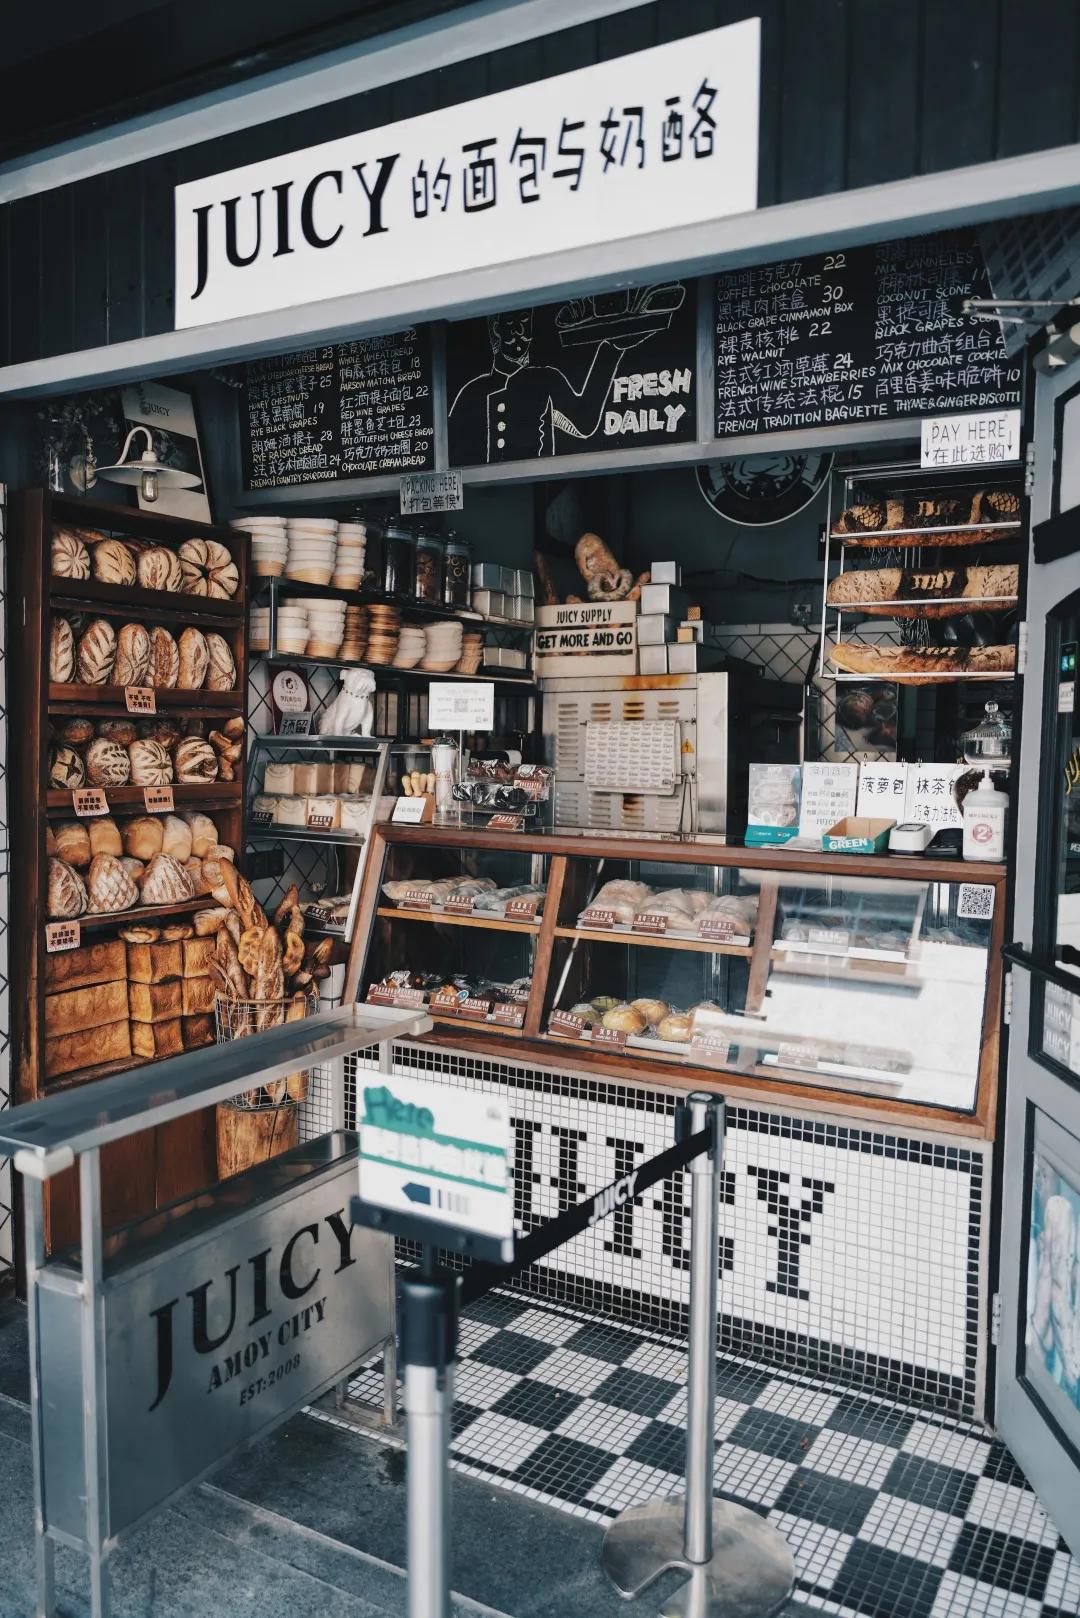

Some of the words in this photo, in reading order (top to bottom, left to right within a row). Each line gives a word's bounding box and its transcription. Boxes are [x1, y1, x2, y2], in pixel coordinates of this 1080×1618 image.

[191, 154, 401, 300] JUICY
[411, 78, 718, 219] 的面包与奶酪
[824, 253, 847, 270] 22
[717, 286, 757, 302] COFFEE
[760, 274, 822, 294] CHOCOLATE
[877, 288, 932, 305] COCONUT
[936, 283, 972, 299] SCONE
[718, 288, 809, 321] 黑提肉桂盒
[822, 285, 844, 304] 30
[875, 298, 952, 326] 黑提司康
[716, 320, 746, 334] BLACK
[748, 315, 778, 328] GRAPE
[778, 306, 832, 323] CINNAMON
[834, 302, 854, 314] BOX
[874, 322, 911, 340] BLACK
[915, 317, 964, 332] GRAPES
[404, 331, 418, 342] 22
[720, 326, 800, 354] 裸麦核桃
[808, 322, 832, 338] 22
[875, 328, 992, 362] 巧克力曲奇组合
[338, 354, 362, 366] WHOLE
[410, 356, 420, 368] 18
[718, 354, 738, 366] RYE
[741, 347, 786, 362] WALNUT
[880, 363, 904, 374] MIX
[906, 354, 963, 371] CHOCOLATE
[366, 376, 396, 388] MATCHA
[397, 370, 422, 383] BREAD
[718, 352, 830, 386] 法式红酒草莓
[834, 352, 854, 370] 24
[320, 374, 332, 388] 25
[612, 368, 692, 402] FRESH
[718, 384, 758, 400] FRENCH
[760, 378, 788, 392] WINE
[790, 366, 876, 388] STRAWBERRIES
[875, 364, 1006, 398] 百里香姜味脆饼
[1006, 368, 1020, 380] 10
[271, 392, 310, 406] CHESTNUTS
[314, 401, 324, 414] 19
[340, 384, 414, 412] 红酒提子面包
[416, 385, 429, 398] 22
[718, 384, 845, 419] 法式传统法棍
[848, 383, 864, 400] 15
[978, 390, 1020, 406] BISCOTTI
[341, 410, 354, 420] RED
[356, 408, 374, 416] WINE
[376, 404, 406, 415] GRAPES
[604, 404, 686, 436] DAILY
[718, 418, 758, 434] FRENCH
[762, 410, 822, 429] TRADITION
[824, 403, 888, 422] BAGUETTE
[250, 427, 264, 438] RYE
[266, 423, 286, 434] BLACK
[289, 416, 318, 429] GRAPES
[320, 430, 333, 442] 28
[340, 414, 408, 437] 胖墨鱼芝士包
[408, 414, 422, 428] 23
[341, 436, 354, 446] FAT
[354, 434, 389, 444] CUTTLEFISH
[390, 429, 414, 440] CHEESE
[414, 427, 434, 438] BREAD
[932, 424, 960, 444] PAY
[968, 418, 1006, 440] HERE
[252, 452, 266, 464] RYE
[269, 446, 298, 460] RAISINS
[414, 440, 428, 452] 20
[932, 444, 1005, 466] 在此选购
[329, 454, 342, 466] 24
[342, 460, 378, 473] CHOCOLATE
[402, 454, 426, 467] BREAD
[250, 476, 276, 490] FRENCH
[276, 474, 303, 485] COUNTRY
[303, 470, 338, 481] SOURDOUGH
[406, 478, 435, 496] PACKING
[440, 476, 456, 492] HERE
[556, 610, 578, 624] JUICY
[581, 609, 612, 622] SUPPLY
[537, 634, 557, 649] GET
[560, 632, 589, 648] MORE
[592, 632, 613, 646] AND
[616, 631, 632, 645] GO
[862, 777, 904, 795] 菠萝包
[829, 838, 868, 850] GREEN
[589, 1170, 638, 1225] JUICY
[510, 1117, 835, 1302] UICY
[149, 1207, 357, 1411] JUICY
[207, 1331, 272, 1394] AMOY
[278, 1296, 328, 1346] CITY
